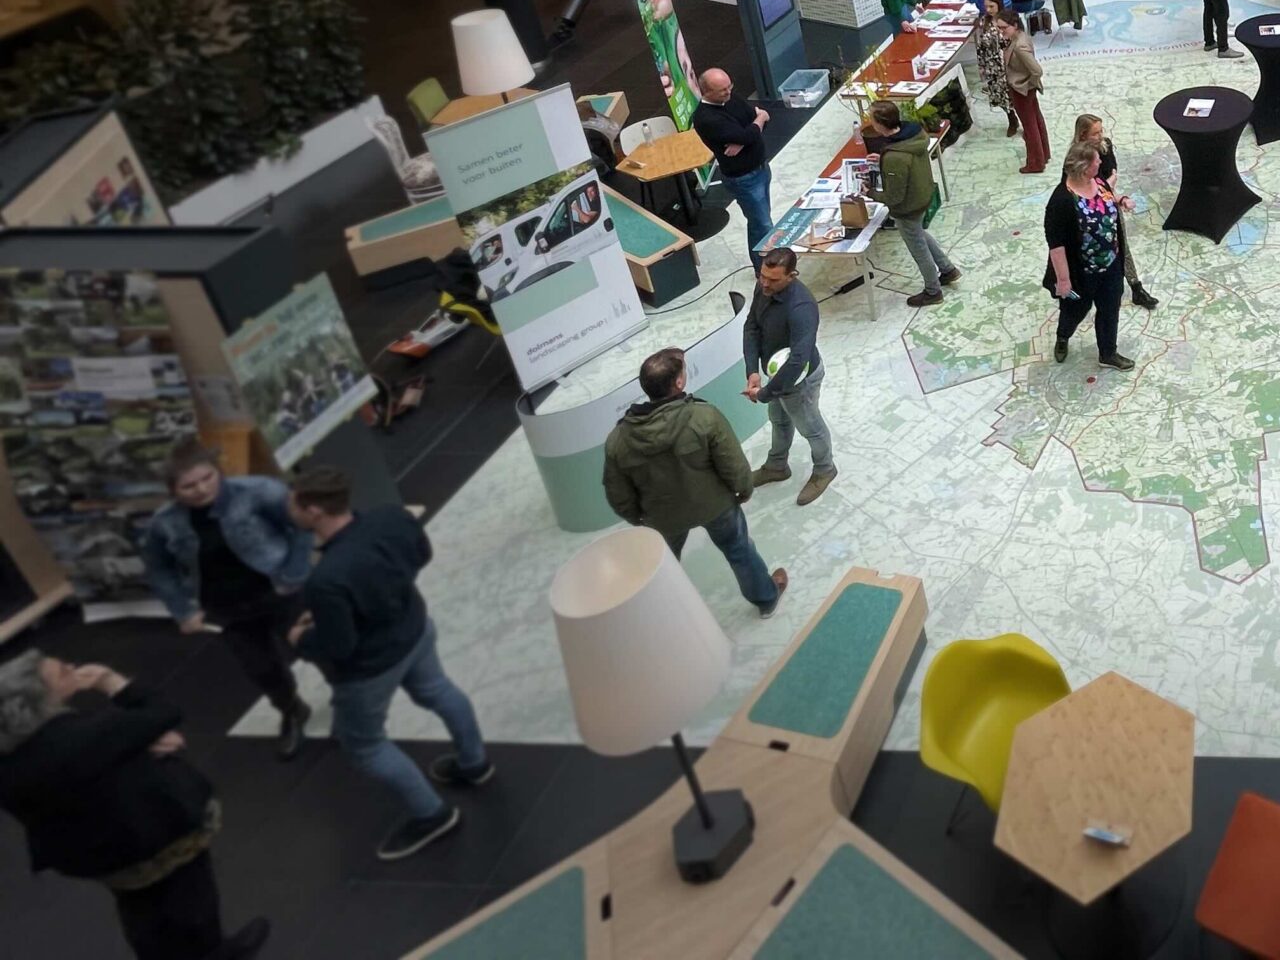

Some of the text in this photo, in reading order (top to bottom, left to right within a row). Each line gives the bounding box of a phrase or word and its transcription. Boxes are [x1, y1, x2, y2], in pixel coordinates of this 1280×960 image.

[1038, 46, 1146, 62] rbeidsmarktregio
[457, 143, 524, 174] Samen beter
[462, 157, 523, 185] voor buiten
[527, 332, 563, 356] dolmans
[528, 333, 580, 363] landscaping
